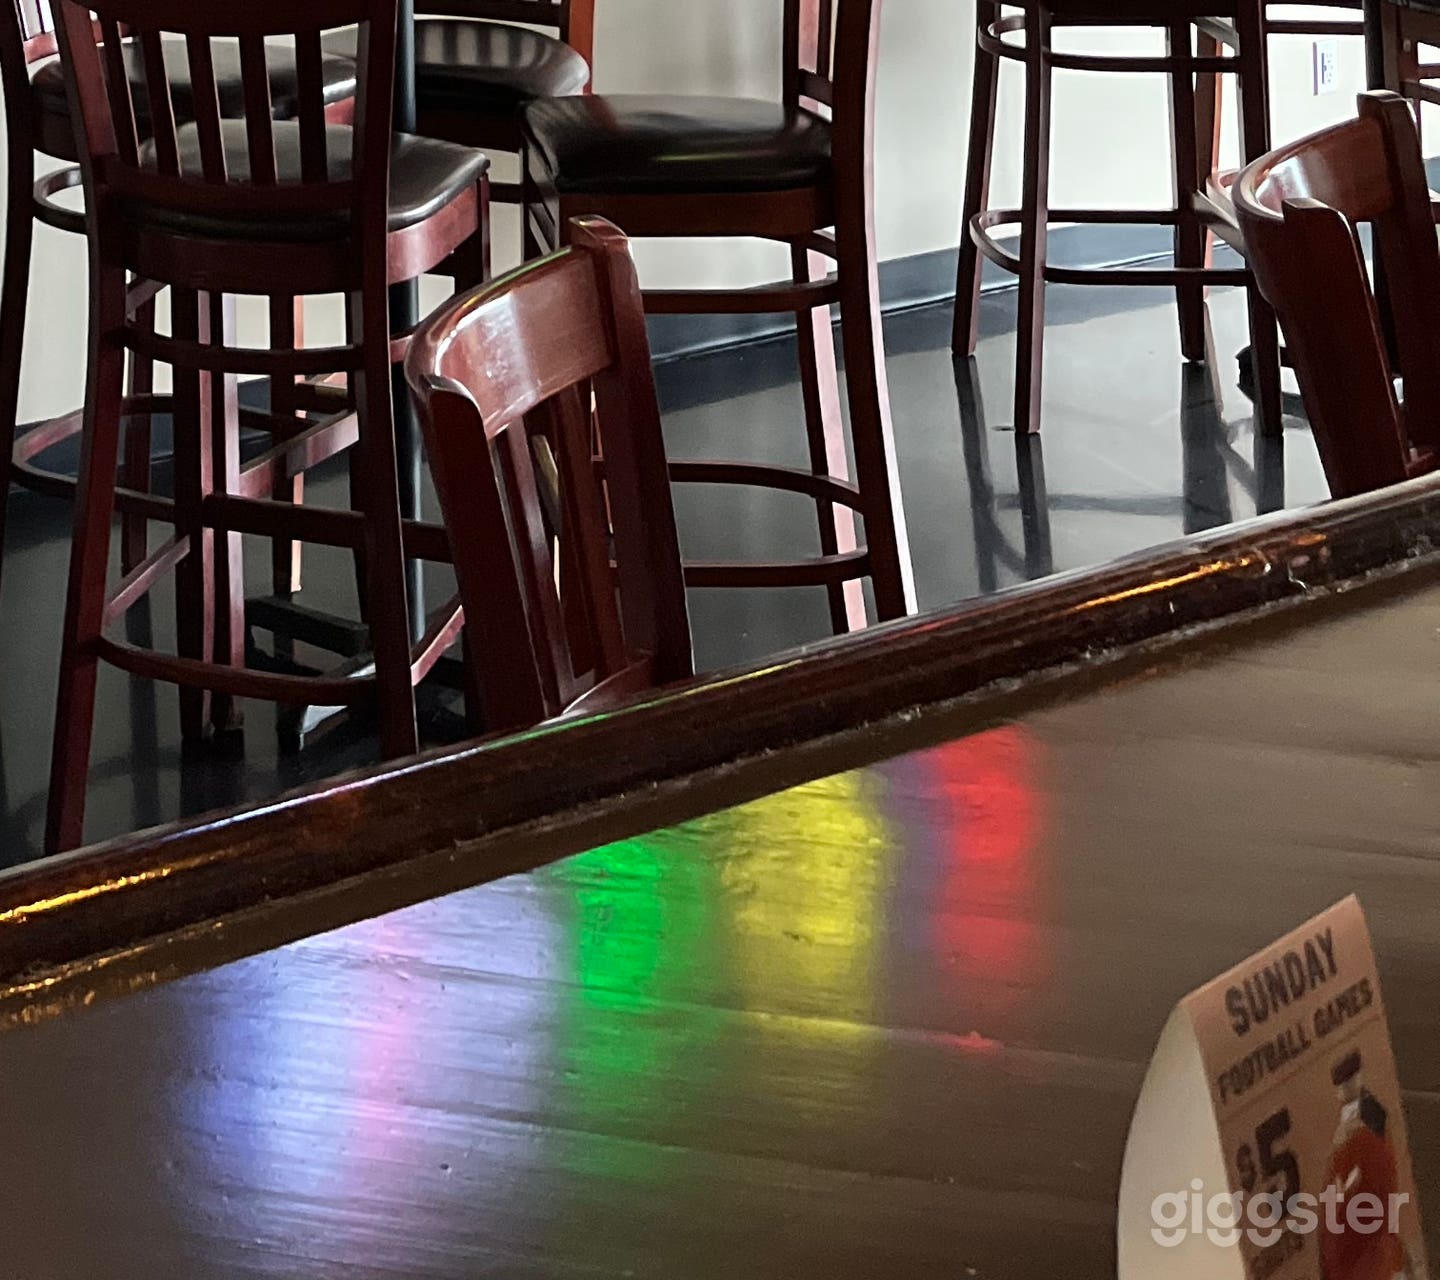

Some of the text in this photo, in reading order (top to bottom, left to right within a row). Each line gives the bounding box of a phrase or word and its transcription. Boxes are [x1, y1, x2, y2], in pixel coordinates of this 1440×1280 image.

[1216, 977, 1375, 1107] FOOTBALL GAMES
[1224, 927, 1338, 1038] SUNDAY
